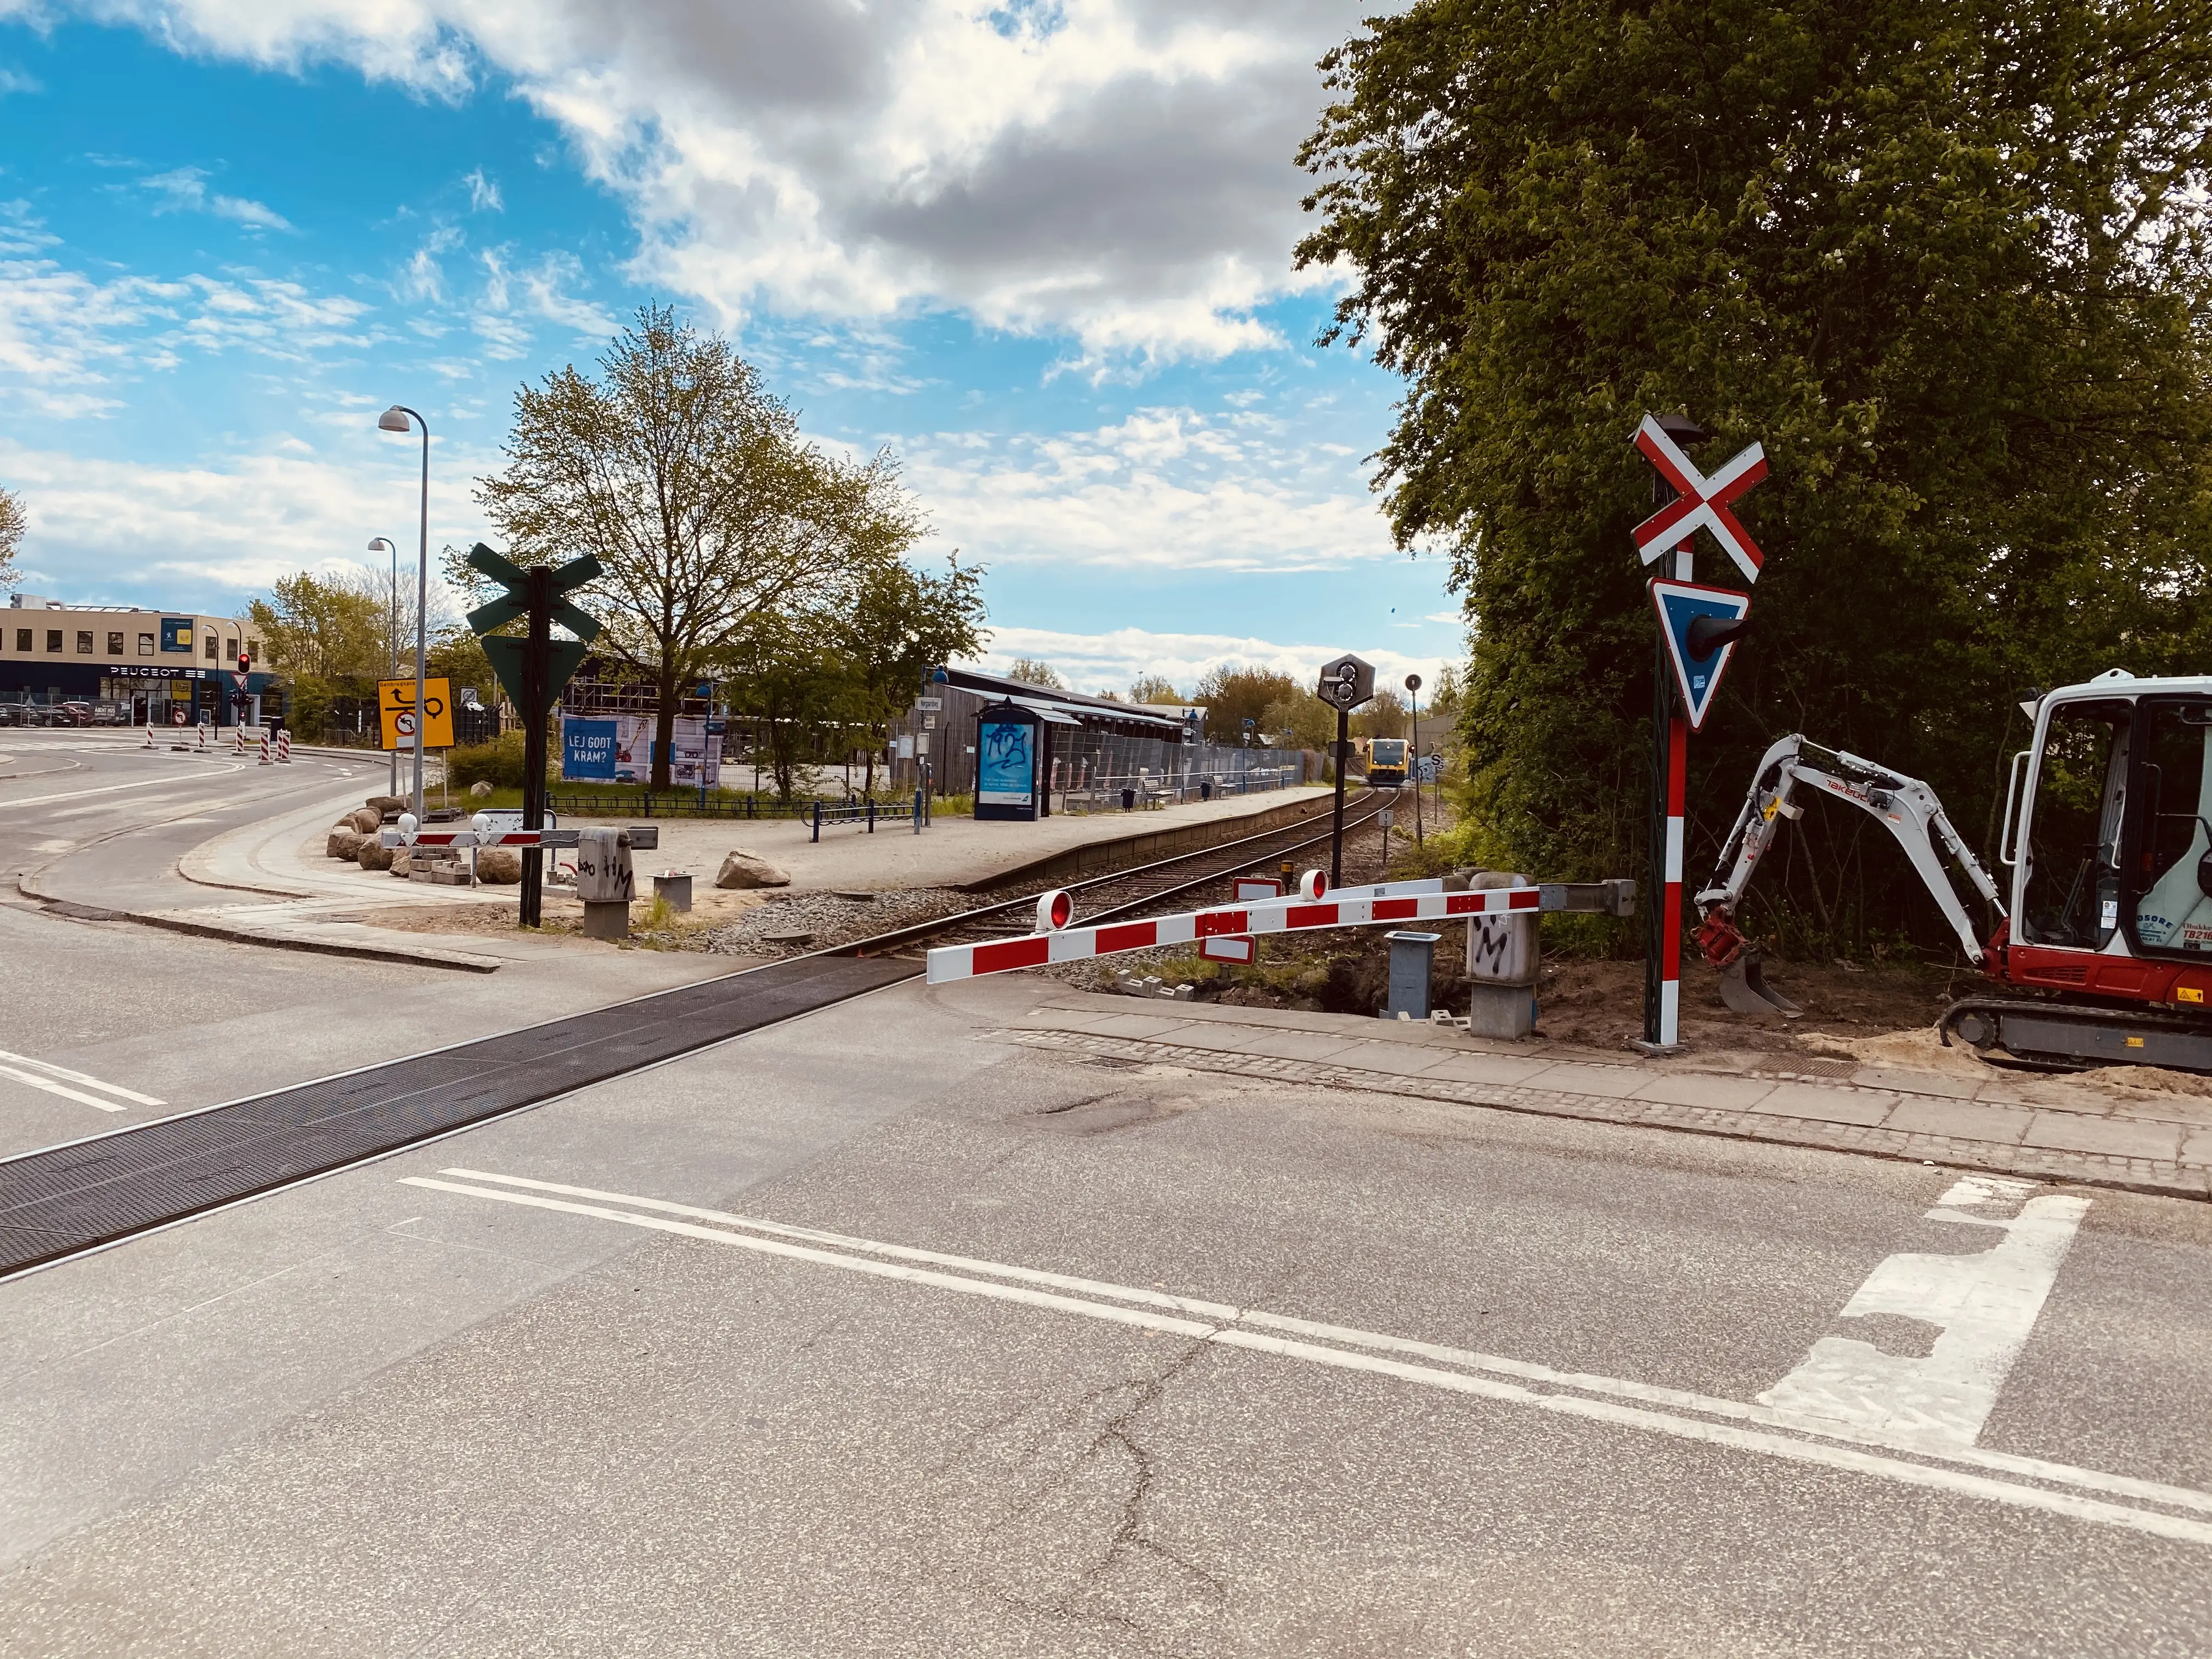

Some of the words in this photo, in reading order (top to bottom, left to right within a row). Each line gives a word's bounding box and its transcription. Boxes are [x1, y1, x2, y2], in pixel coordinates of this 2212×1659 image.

[110, 667, 179, 677] PEUGEOT
[569, 736, 585, 747] LEJ
[588, 736, 612, 749] GODT
[574, 750, 607, 763] KRAM?
[1431, 754, 1441, 766] S
